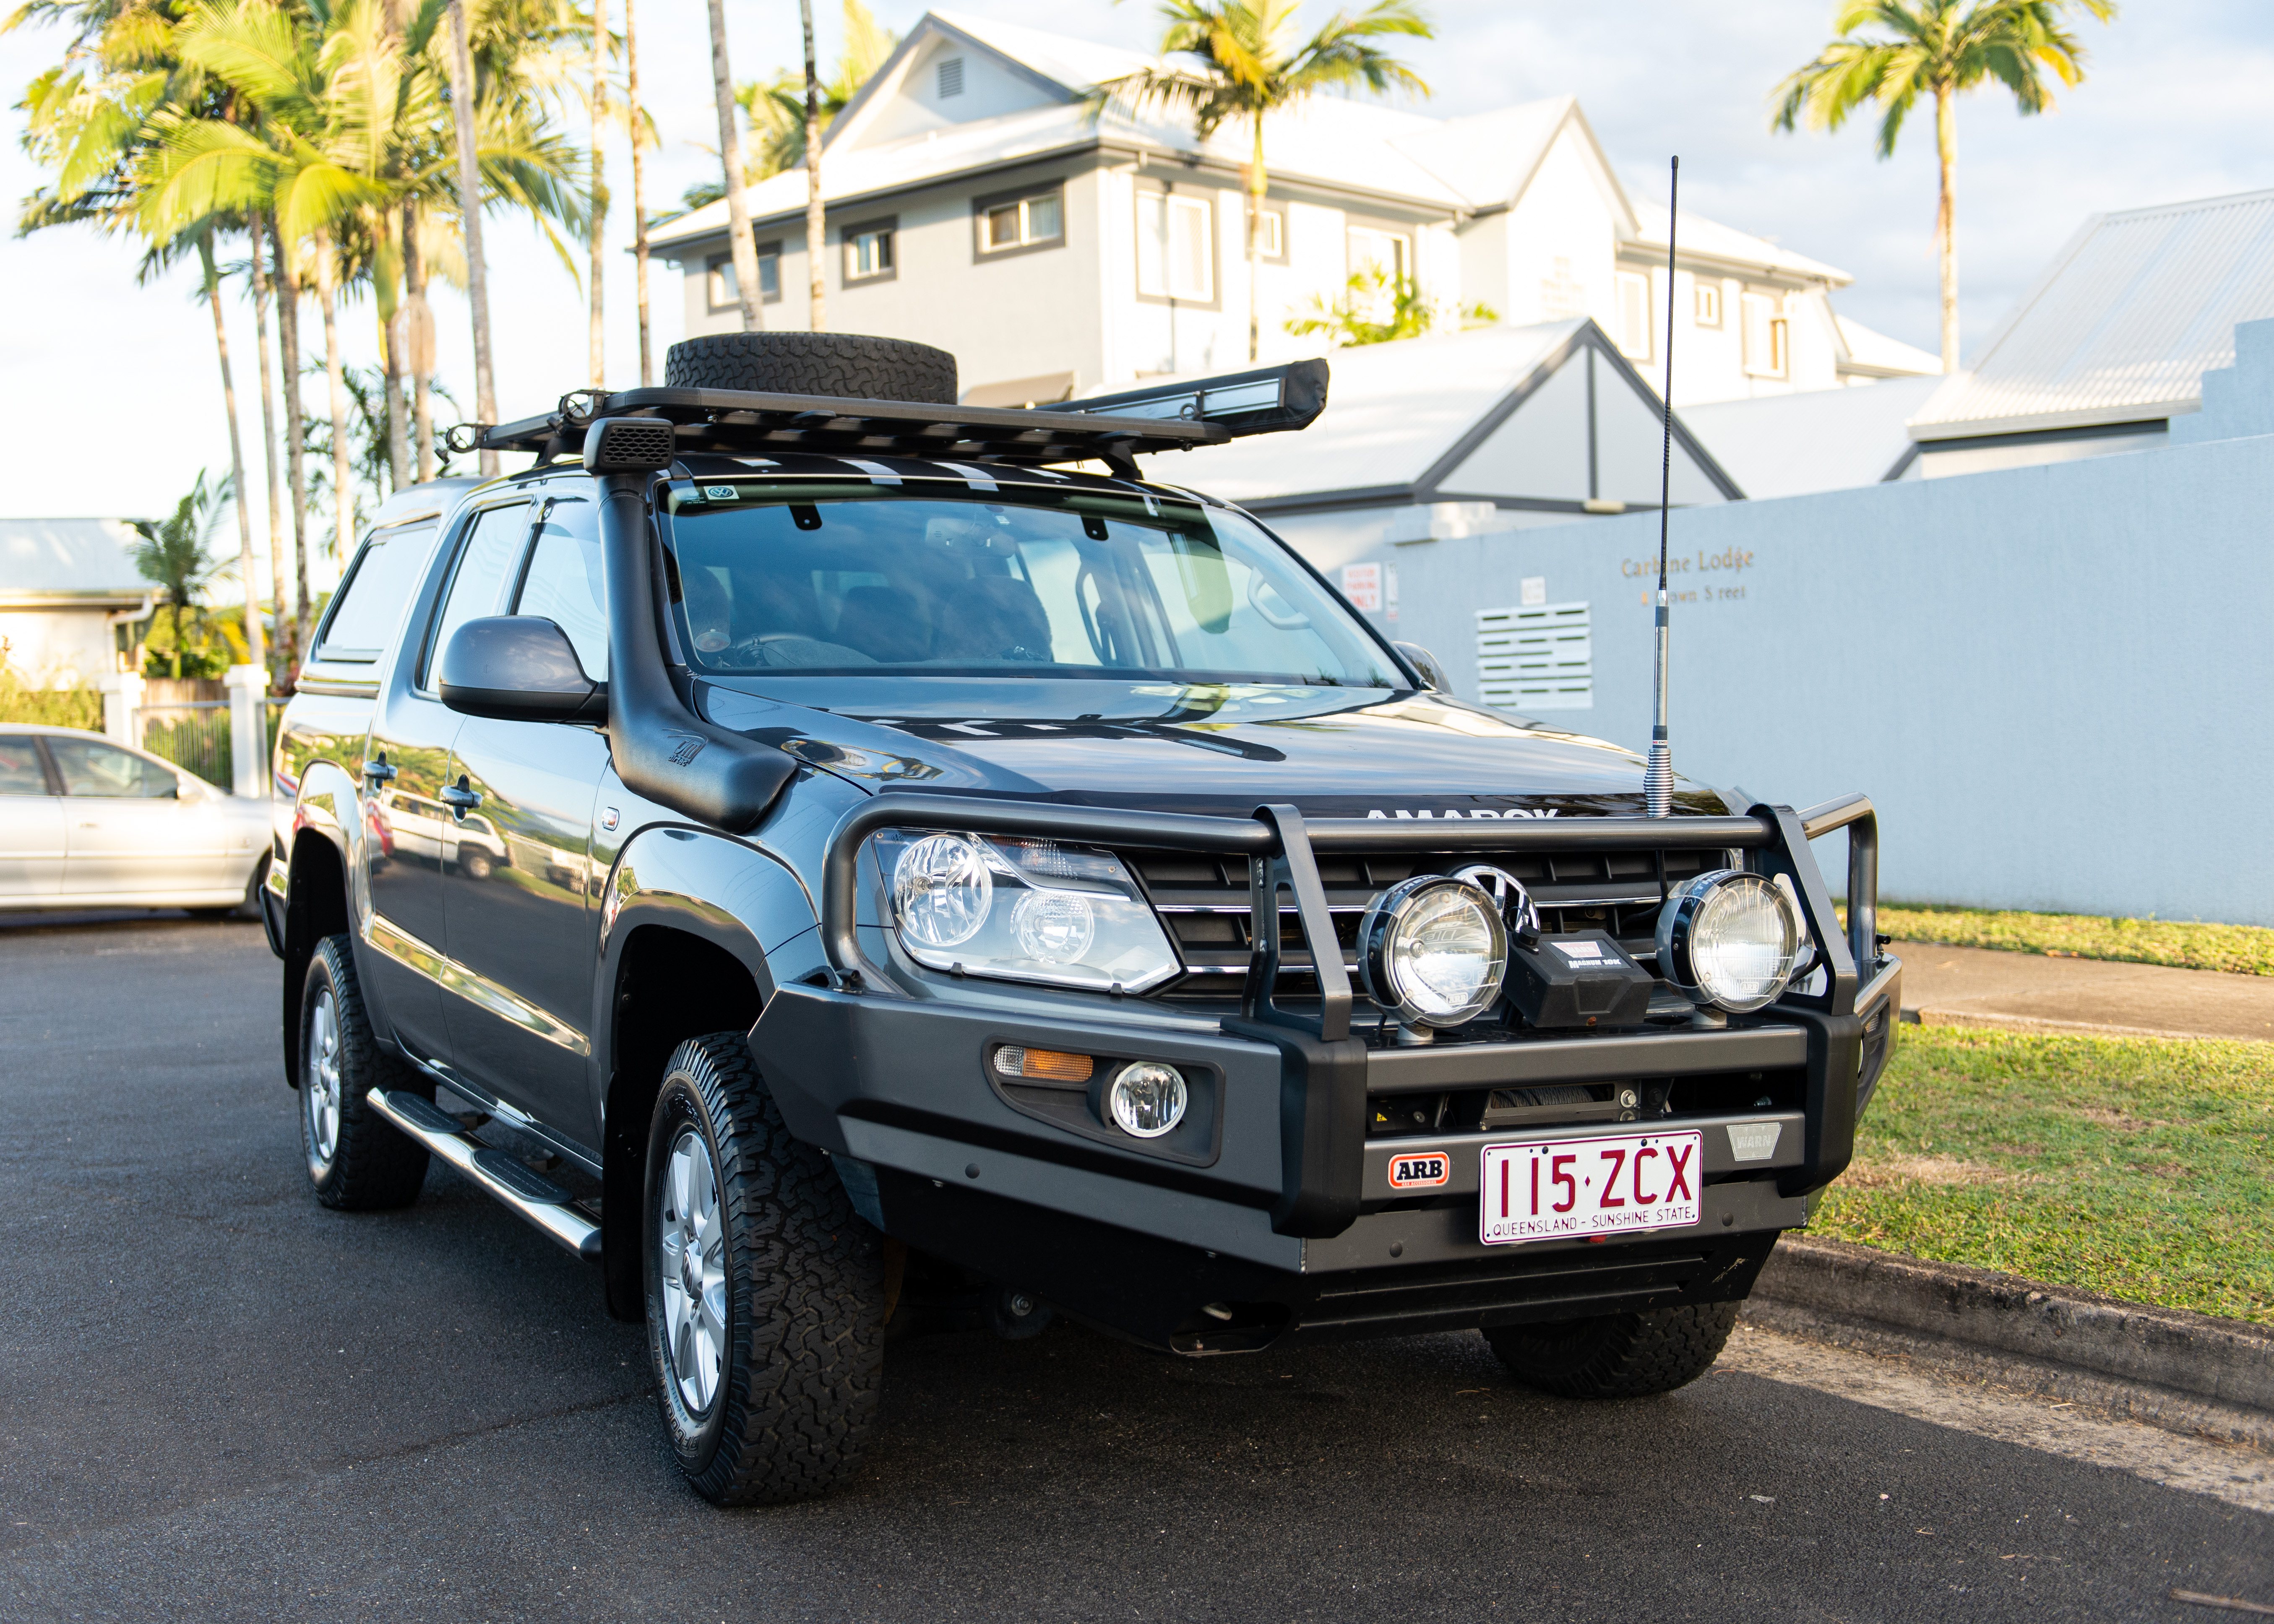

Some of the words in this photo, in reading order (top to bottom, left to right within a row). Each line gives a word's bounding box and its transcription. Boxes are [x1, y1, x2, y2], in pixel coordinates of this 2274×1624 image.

[1622, 554, 1690, 578] Carbne
[1698, 546, 1754, 573] Lodge
[1448, 994, 1466, 1004] ARB
[1737, 1135, 1771, 1148] WARN
[1396, 1160, 1443, 1181] ARB
[1493, 1217, 1577, 1236] QUEENSLAND
[1592, 1210, 1649, 1227] SUNSHINE
[1657, 1206, 1691, 1222] STATE
